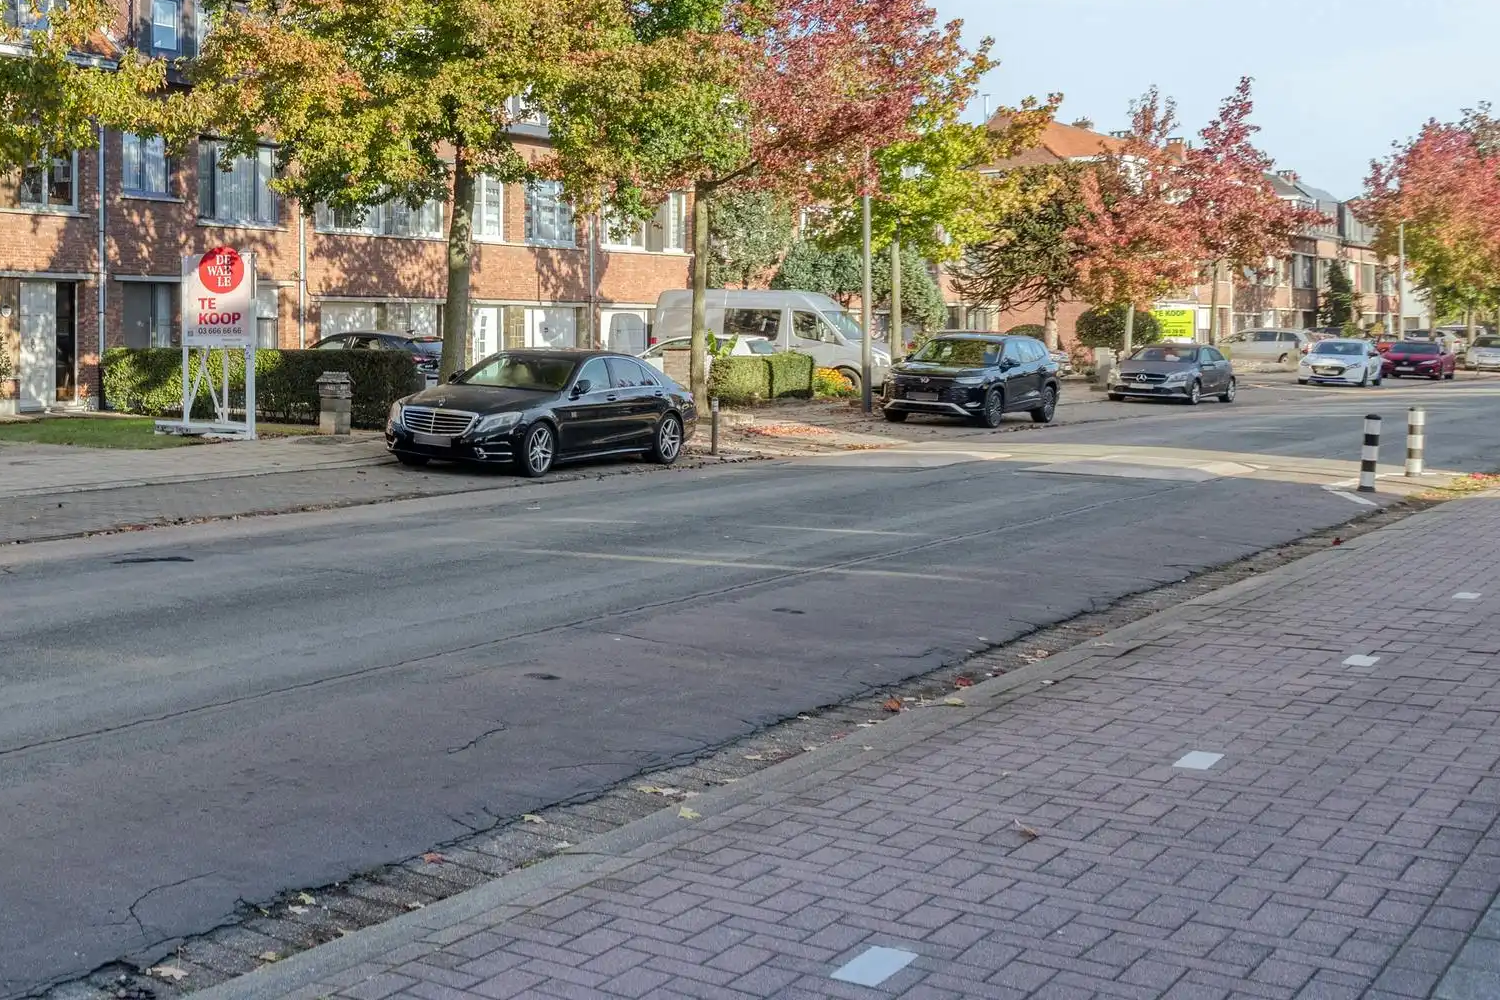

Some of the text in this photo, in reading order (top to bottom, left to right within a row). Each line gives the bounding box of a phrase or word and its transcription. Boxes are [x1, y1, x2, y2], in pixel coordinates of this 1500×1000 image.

[216, 254, 231, 265] DE
[207, 265, 231, 276] WAE
[217, 276, 231, 287] LE
[198, 297, 216, 310] TE
[198, 312, 241, 325] KOOP
[198, 327, 207, 335] 03
[208, 327, 221, 335] 666
[222, 327, 231, 335] 66
